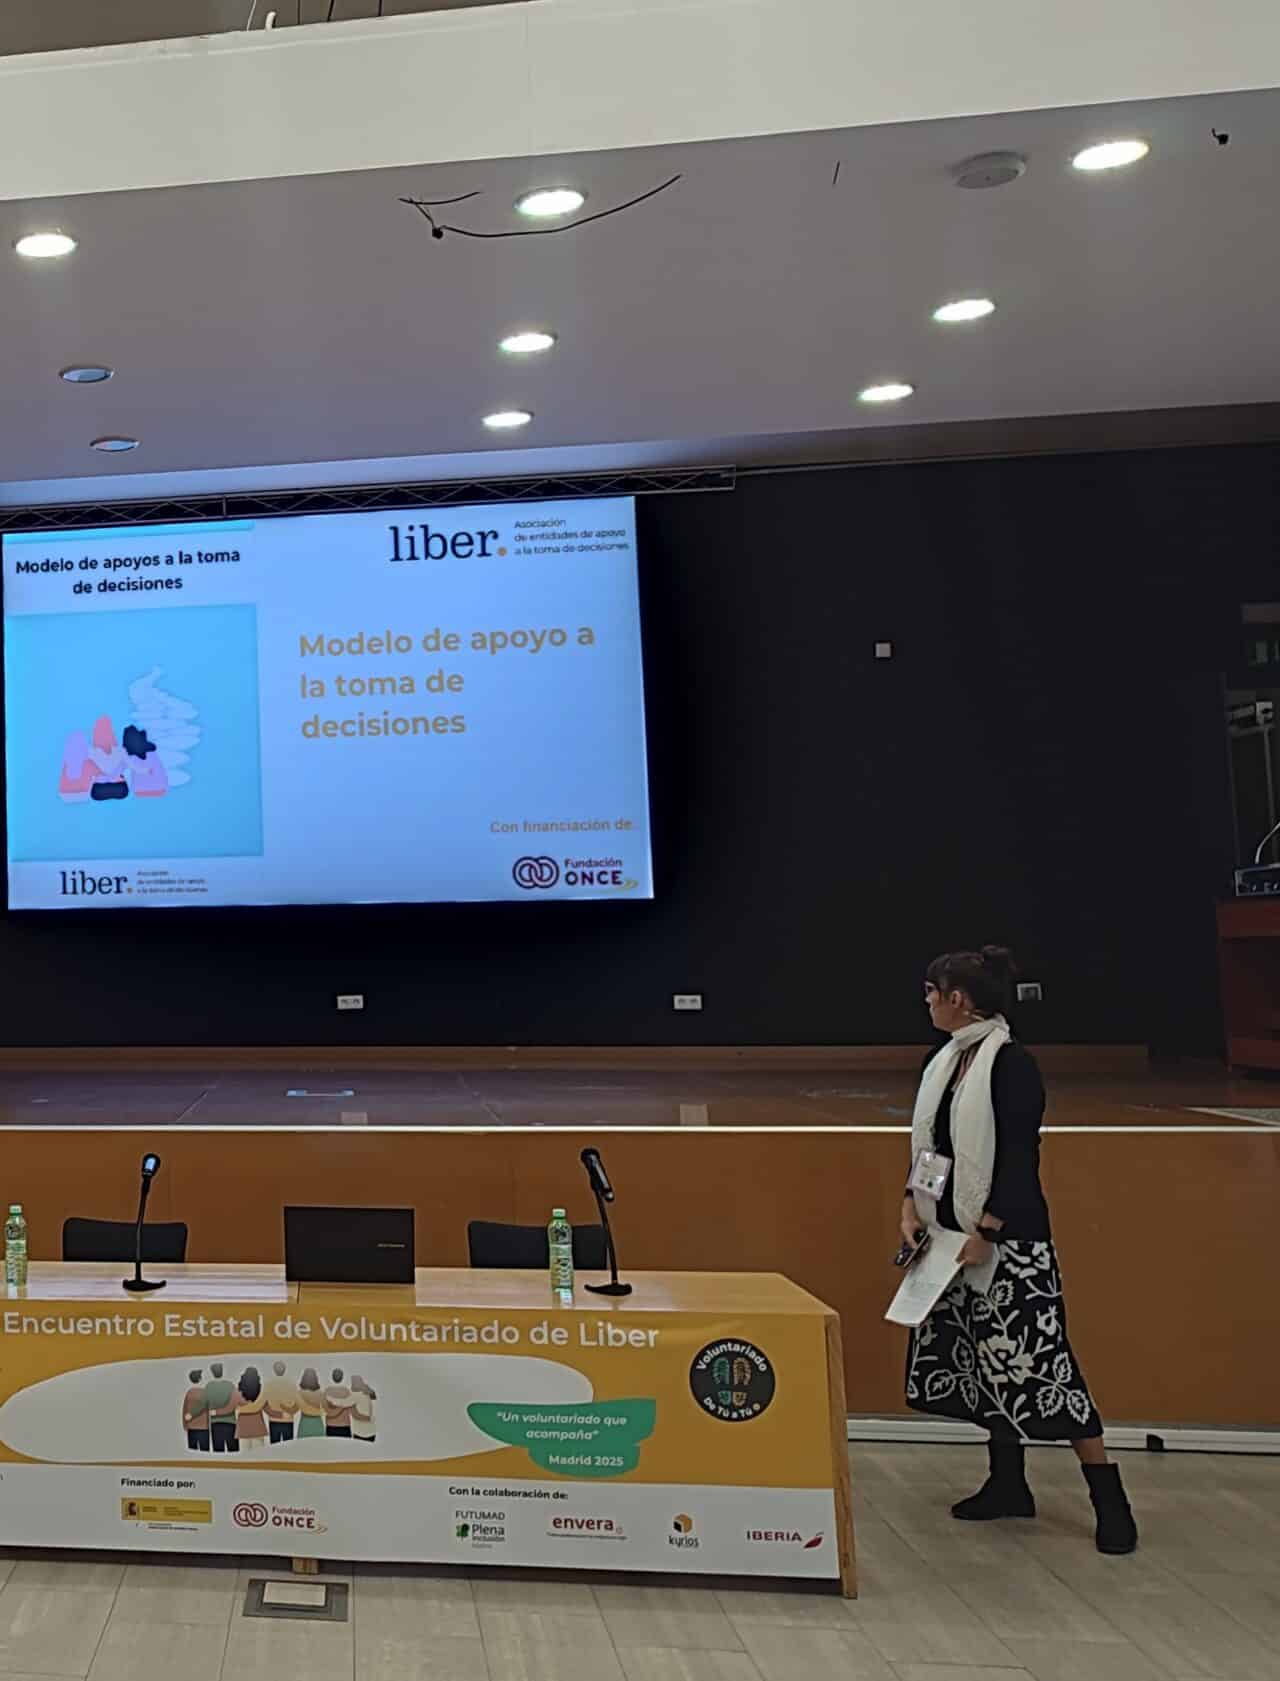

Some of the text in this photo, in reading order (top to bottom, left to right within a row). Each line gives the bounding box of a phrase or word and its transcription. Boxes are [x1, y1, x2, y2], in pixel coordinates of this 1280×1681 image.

[16, 550, 240, 574] Modelo de apoyos a la toma
[73, 576, 183, 594] de decisiones
[299, 627, 595, 657] Modelo de apoyo a
[300, 668, 464, 698] la toma de
[301, 710, 466, 739] decisiones
[490, 821, 519, 833] Con
[564, 858, 622, 868] Fundación
[564, 870, 624, 886] ONCE
[4, 1311, 155, 1336] Encuentro
[165, 1314, 264, 1338] Estatal
[274, 1316, 312, 1339] de
[320, 1317, 520, 1344] Voluntariado
[529, 1321, 569, 1346] de
[579, 1321, 660, 1347] Liber
[695, 1342, 767, 1372] Voluntariado
[522, 1412, 600, 1424] voluntariado
[603, 1416, 627, 1427] que
[549, 1455, 624, 1466] Madrid 2025
[121, 1478, 175, 1488] Financiado
[448, 1486, 469, 1496] Con
[471, 1487, 481, 1496] la
[483, 1488, 551, 1500] colaboración
[271, 1515, 316, 1529] ONCE
[456, 1510, 505, 1521] FUTUMAD
[472, 1523, 505, 1536] Plena
[552, 1516, 614, 1531] envera
[669, 1535, 699, 1548] kyrios
[746, 1530, 802, 1542] IBERIA
